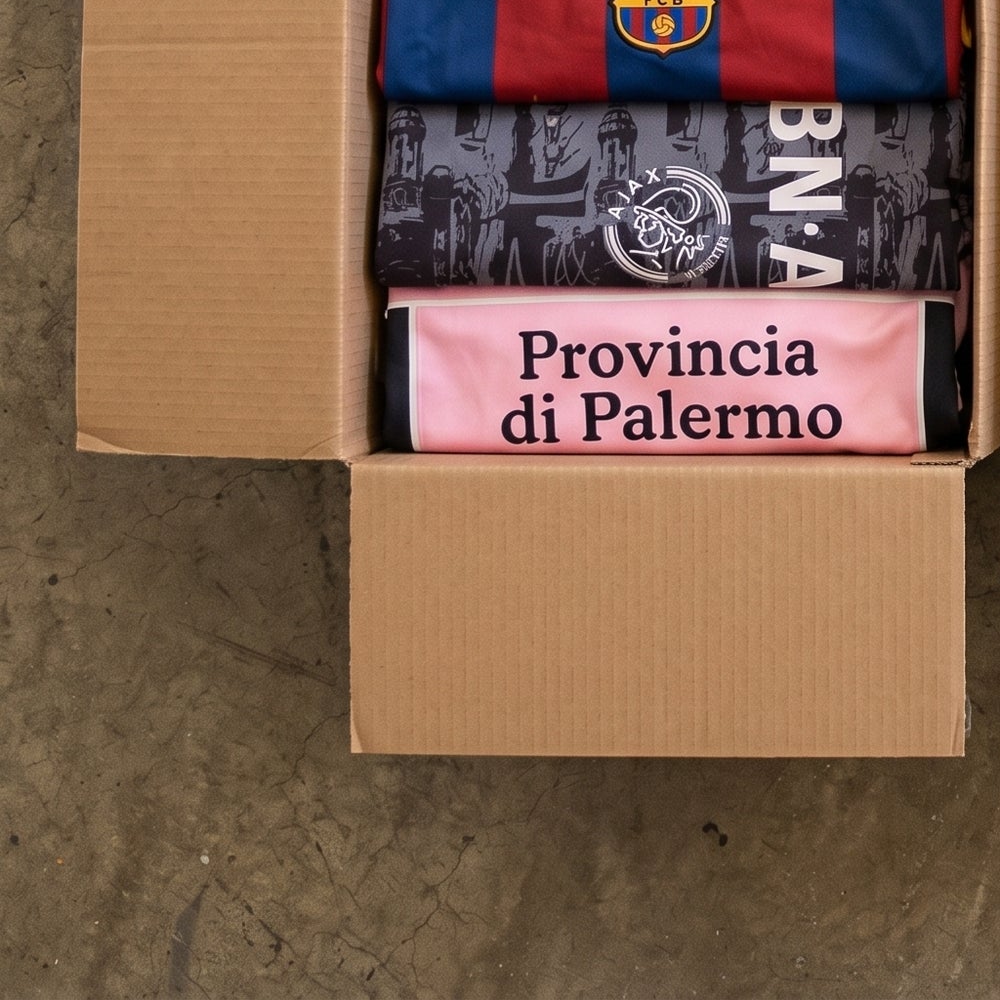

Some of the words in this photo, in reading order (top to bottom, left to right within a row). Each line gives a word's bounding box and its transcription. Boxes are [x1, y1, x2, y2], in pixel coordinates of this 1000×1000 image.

[608, 167, 661, 220] AJAX
[518, 324, 819, 380] Provincia
[501, 392, 560, 445] di
[580, 389, 843, 442] Palermo
